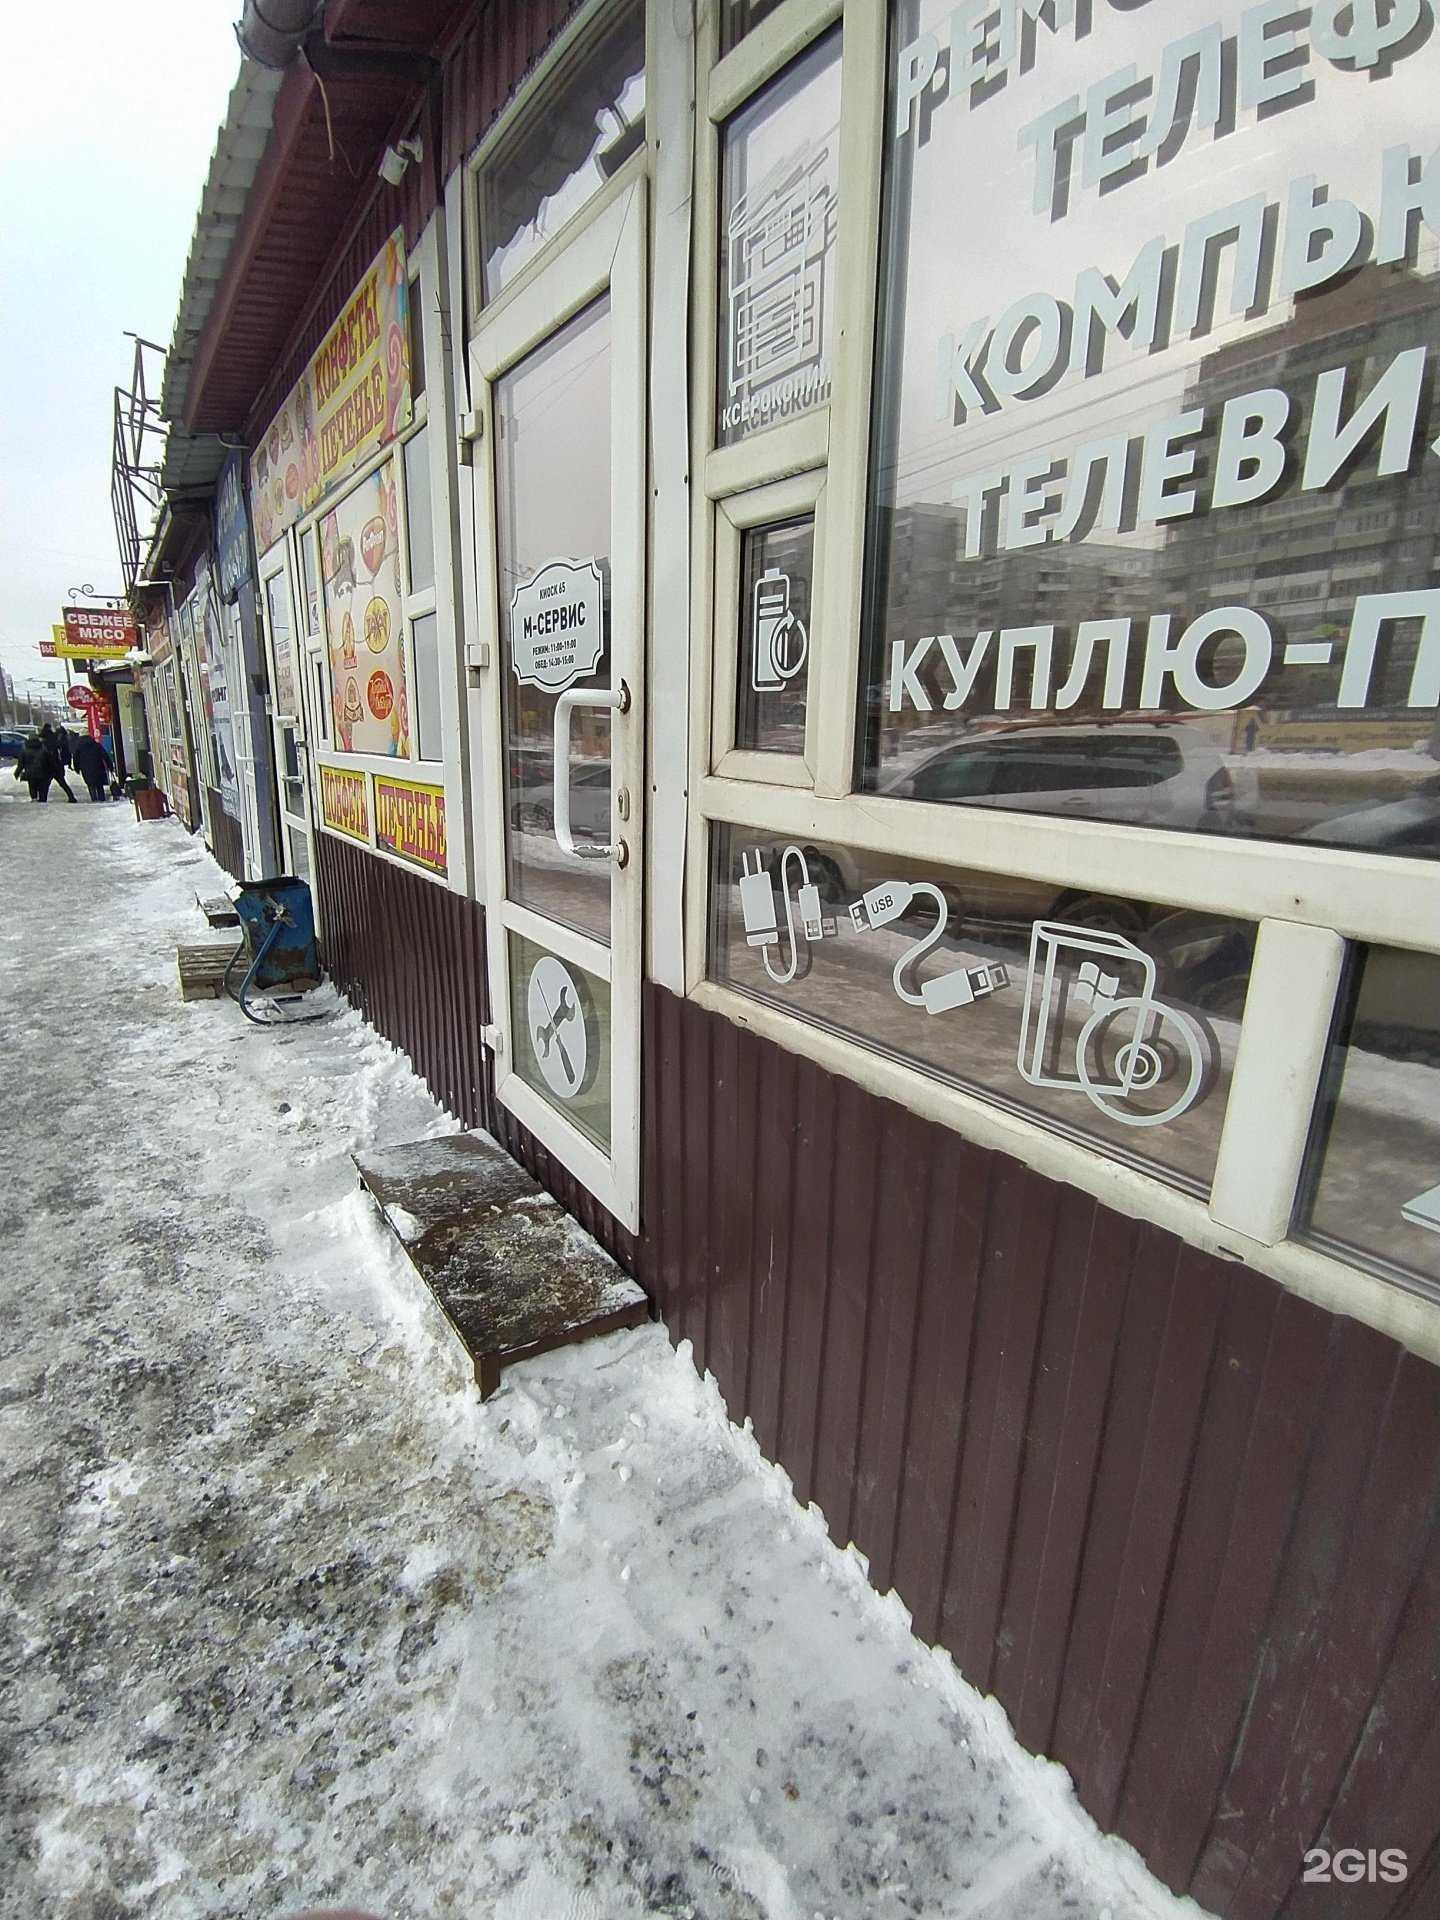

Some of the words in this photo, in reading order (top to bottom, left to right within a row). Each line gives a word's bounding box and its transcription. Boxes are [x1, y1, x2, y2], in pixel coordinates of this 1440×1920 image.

[896, 0, 1155, 138] РЕМ
[1017, 0, 1440, 216] ТЕЛЕФ
[315, 271, 380, 412] КОНФЕТЫ
[320, 361, 384, 475] ПЕЧЕНЬЕ
[953, 346, 1440, 558] ТЕЛЕВИ
[67, 613, 134, 628] СВЕЖЕЕ
[79, 627, 125, 640] МЯСО
[523, 601, 586, 639] М-СЕРВИС
[539, 585, 558, 600] КИОСК
[558, 582, 566, 594] 65
[889, 588, 1440, 711] КУПЛЮ-П
[375, 782, 446, 868] ПЕЧЕНЬЕ
[870, 894, 894, 914] USB
